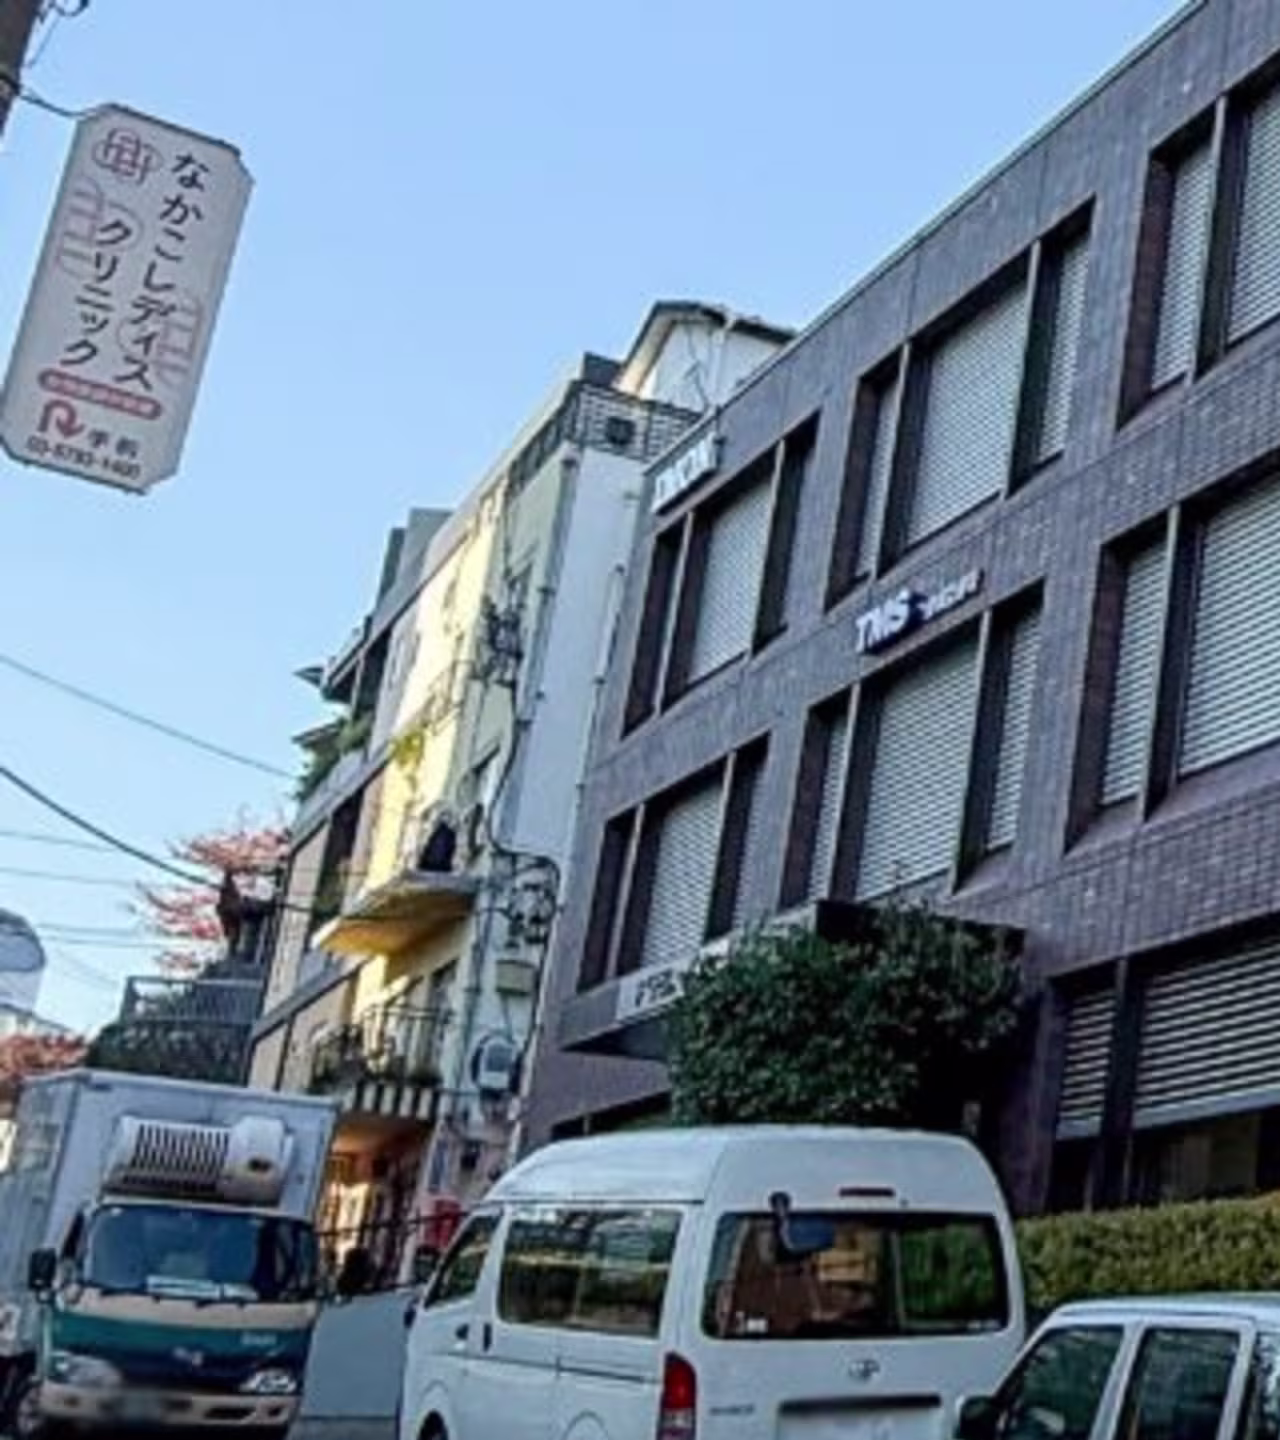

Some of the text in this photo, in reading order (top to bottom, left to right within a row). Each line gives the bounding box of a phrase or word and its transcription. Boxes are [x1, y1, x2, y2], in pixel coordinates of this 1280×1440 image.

[60, 220, 132, 366] クリニック
